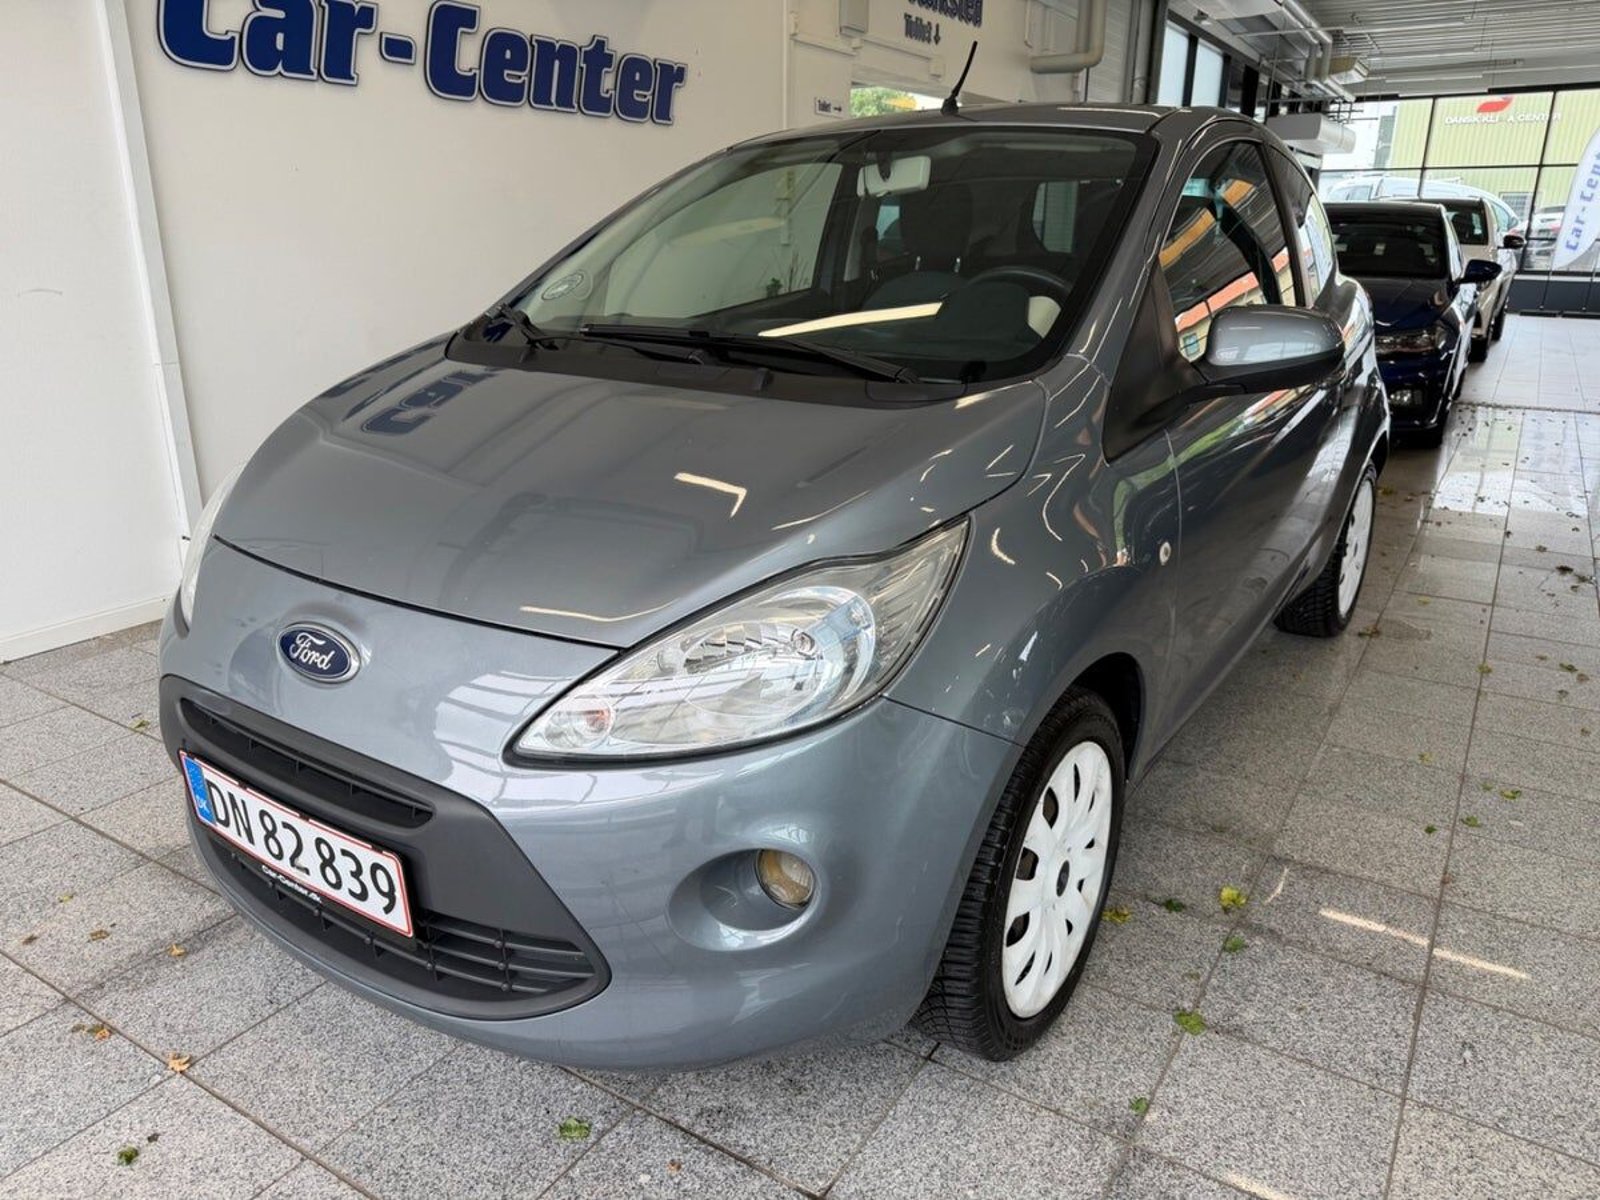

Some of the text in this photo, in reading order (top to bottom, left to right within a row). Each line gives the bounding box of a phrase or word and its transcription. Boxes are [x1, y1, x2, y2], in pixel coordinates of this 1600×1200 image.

[157, 0, 688, 126] Car-Center
[1481, 113, 1514, 124] KLIA
[289, 632, 335, 670] Ford
[207, 779, 397, 915] DN 82 839
